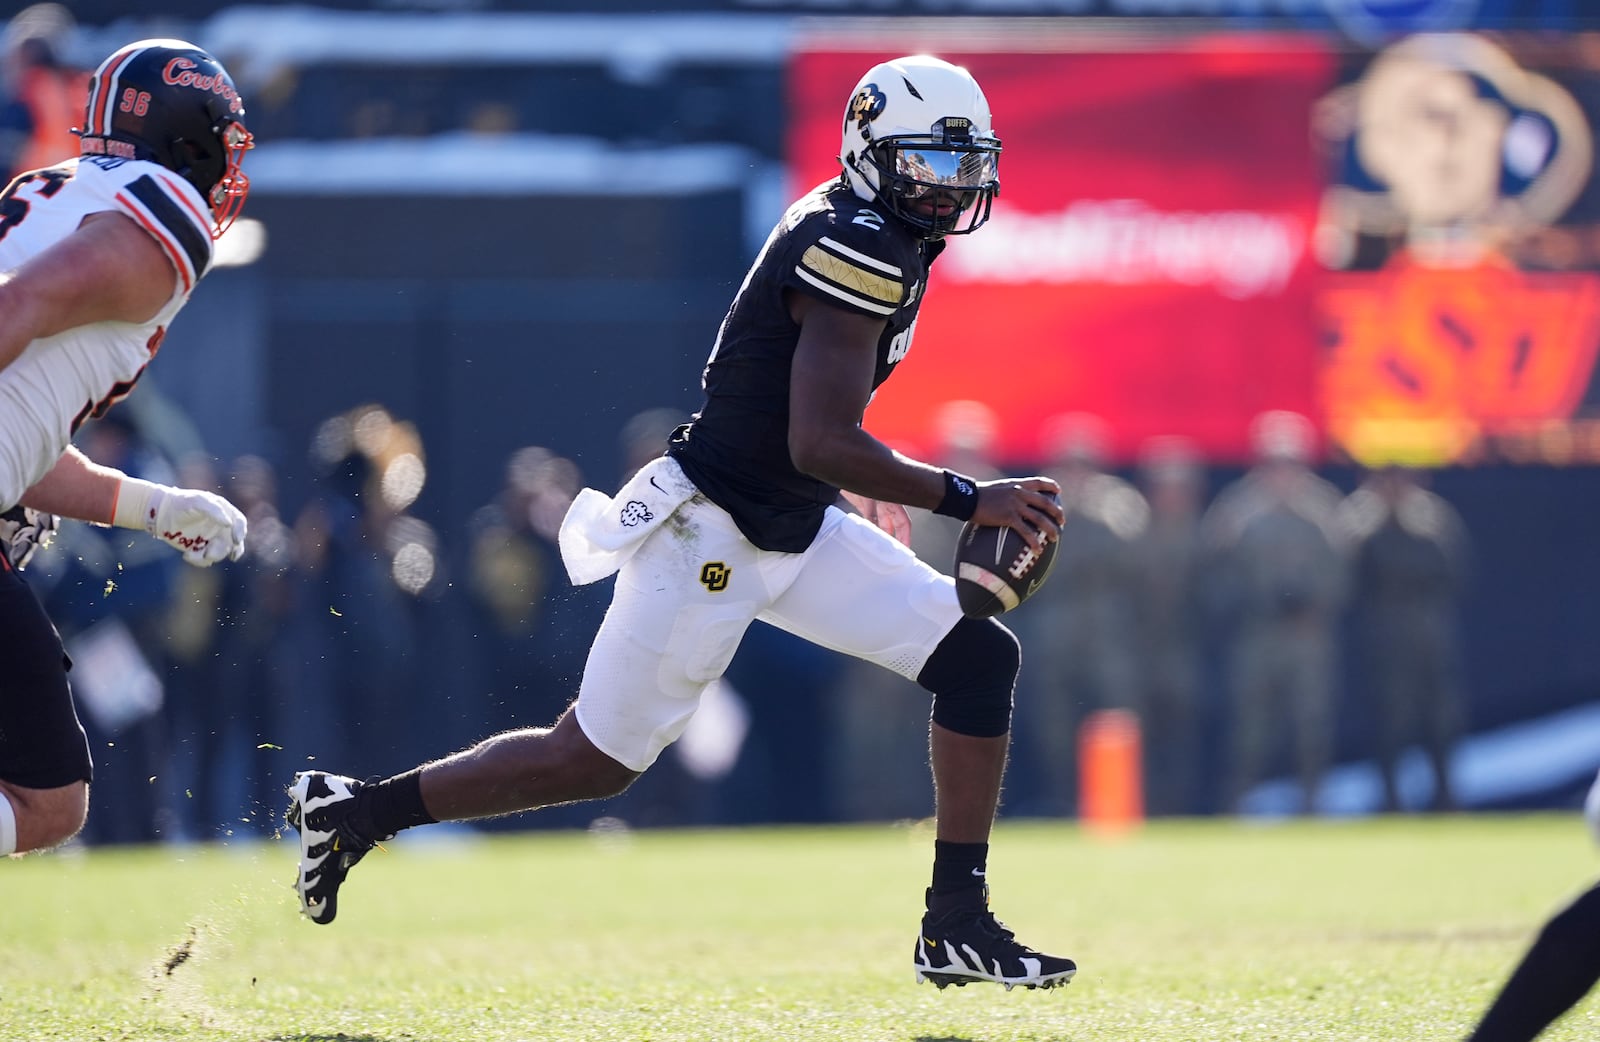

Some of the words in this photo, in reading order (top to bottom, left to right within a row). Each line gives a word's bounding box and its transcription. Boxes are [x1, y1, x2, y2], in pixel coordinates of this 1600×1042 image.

[162, 57, 242, 113] Cowboy
[120, 87, 152, 117] 96
[945, 118, 968, 128] BUFFS
[851, 209, 885, 231] 2
[699, 561, 732, 592] CU
